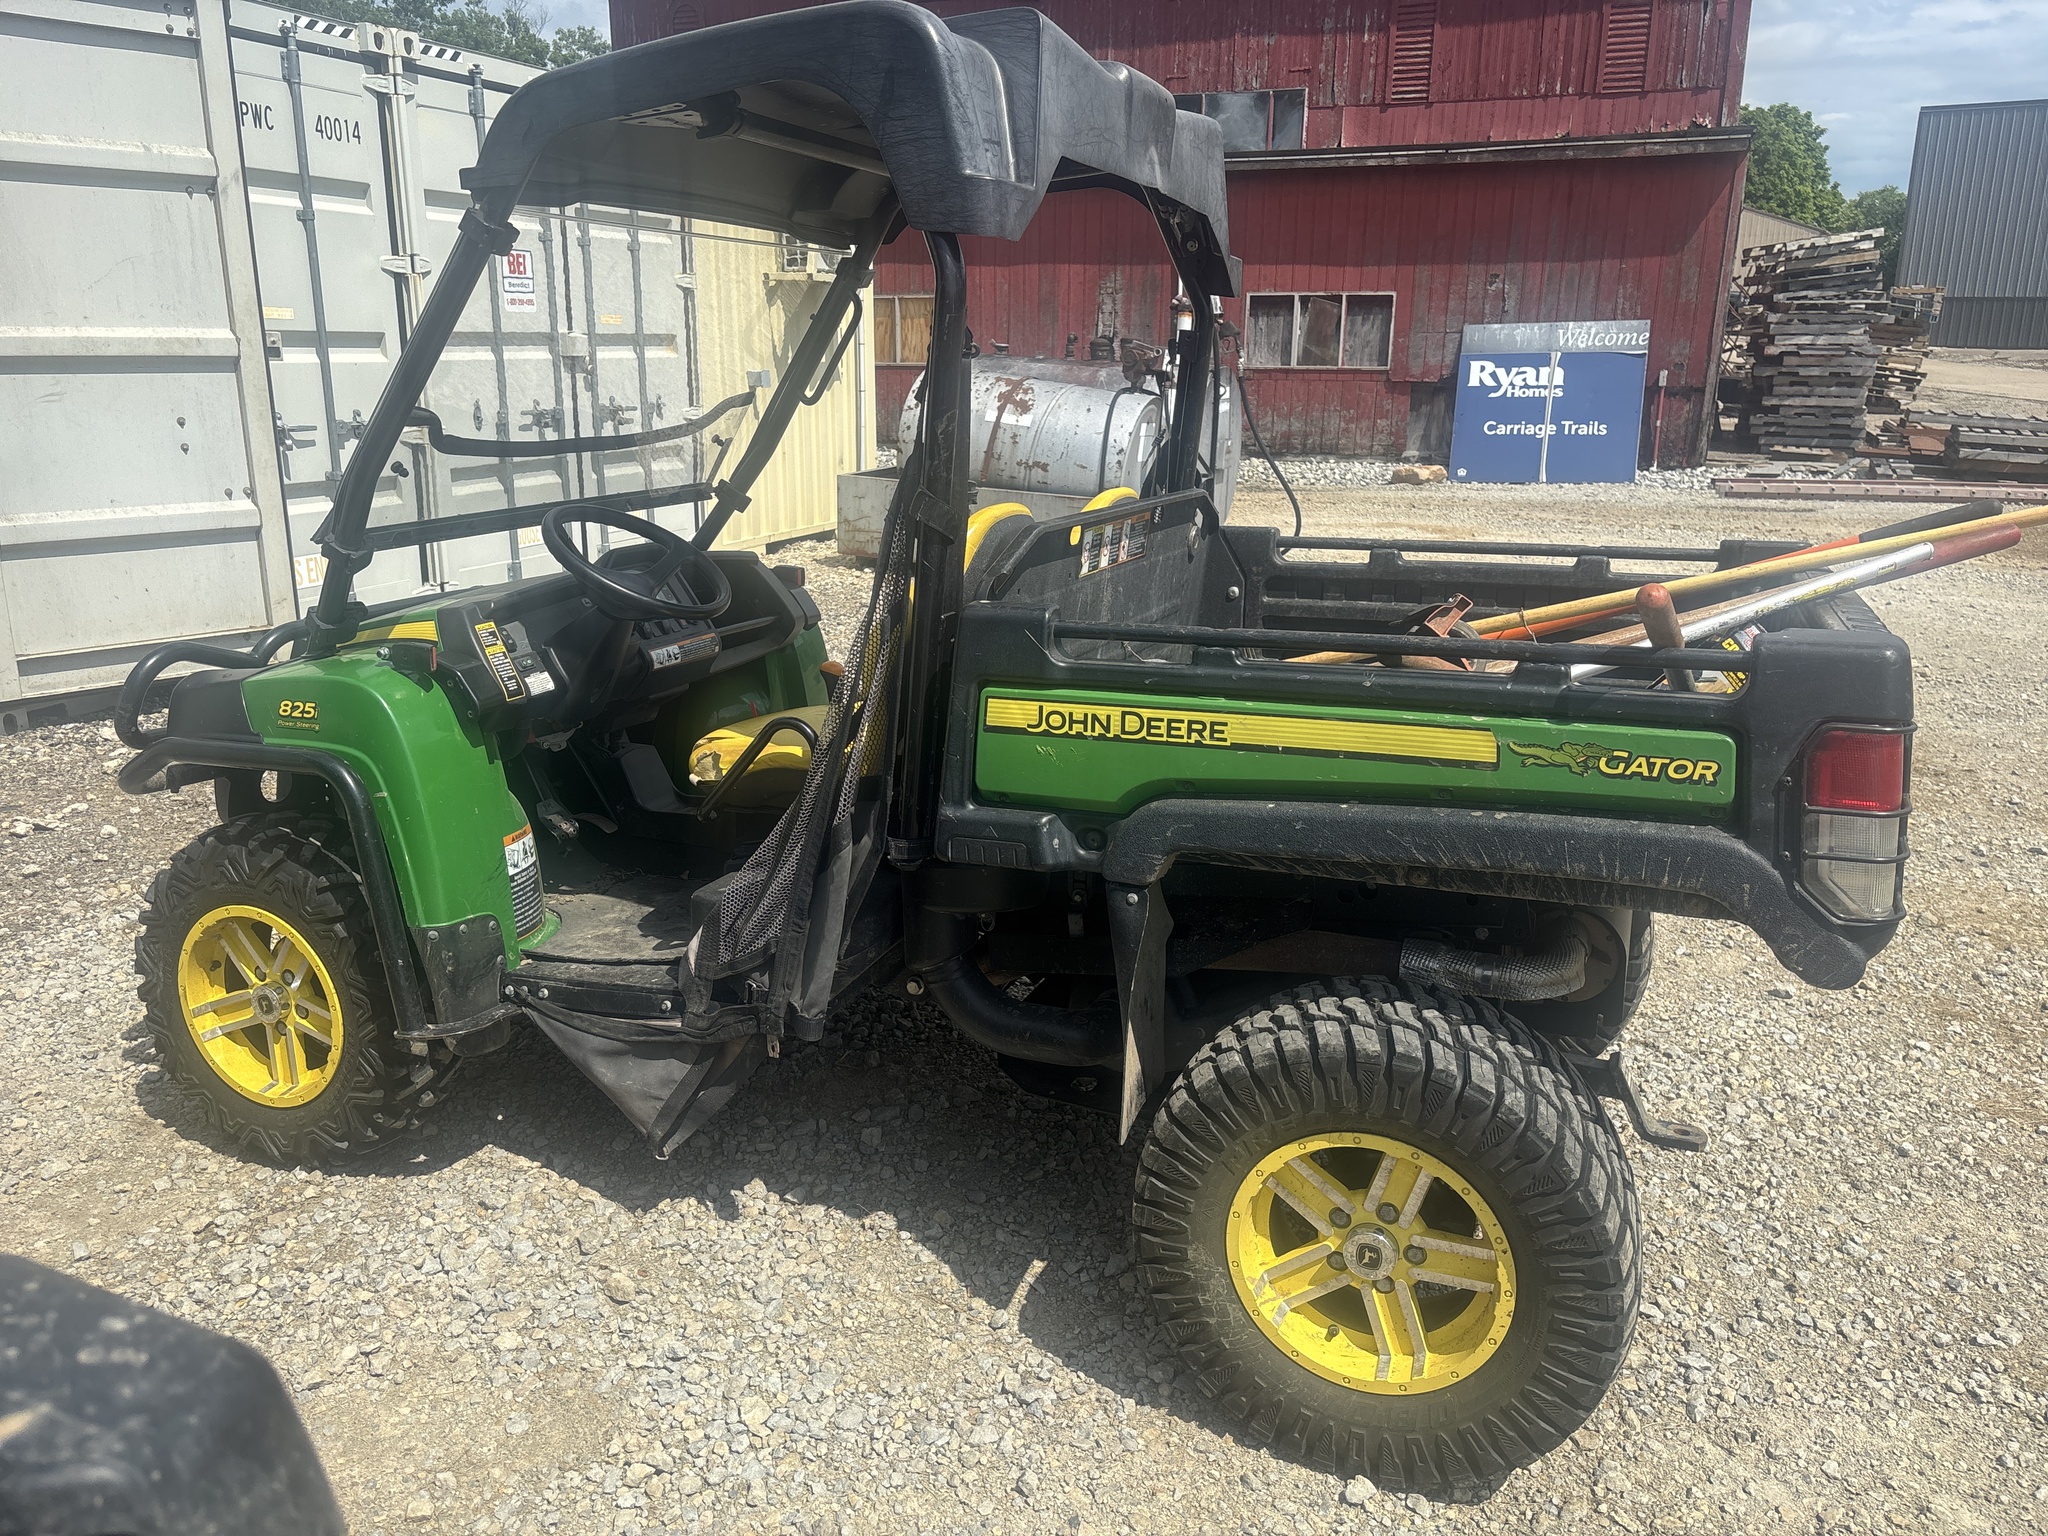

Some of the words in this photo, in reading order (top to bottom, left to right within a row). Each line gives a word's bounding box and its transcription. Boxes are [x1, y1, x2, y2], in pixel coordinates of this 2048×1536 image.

[239, 101, 274, 131] PWC
[315, 114, 361, 145] 40014
[507, 252, 527, 275] BEI
[1557, 327, 1650, 347] Welcome
[1467, 360, 1565, 398] Ryan
[1506, 385, 1564, 398] Homes
[1483, 420, 1557, 438] Carriage
[1561, 420, 1608, 436] Trails
[279, 700, 319, 719] 825i
[277, 719, 295, 727] Power
[295, 721, 320, 730] Steering
[1026, 704, 1112, 735] JOHN
[1120, 710, 1229, 743] DEERE
[1599, 750, 1719, 783] GATOR
